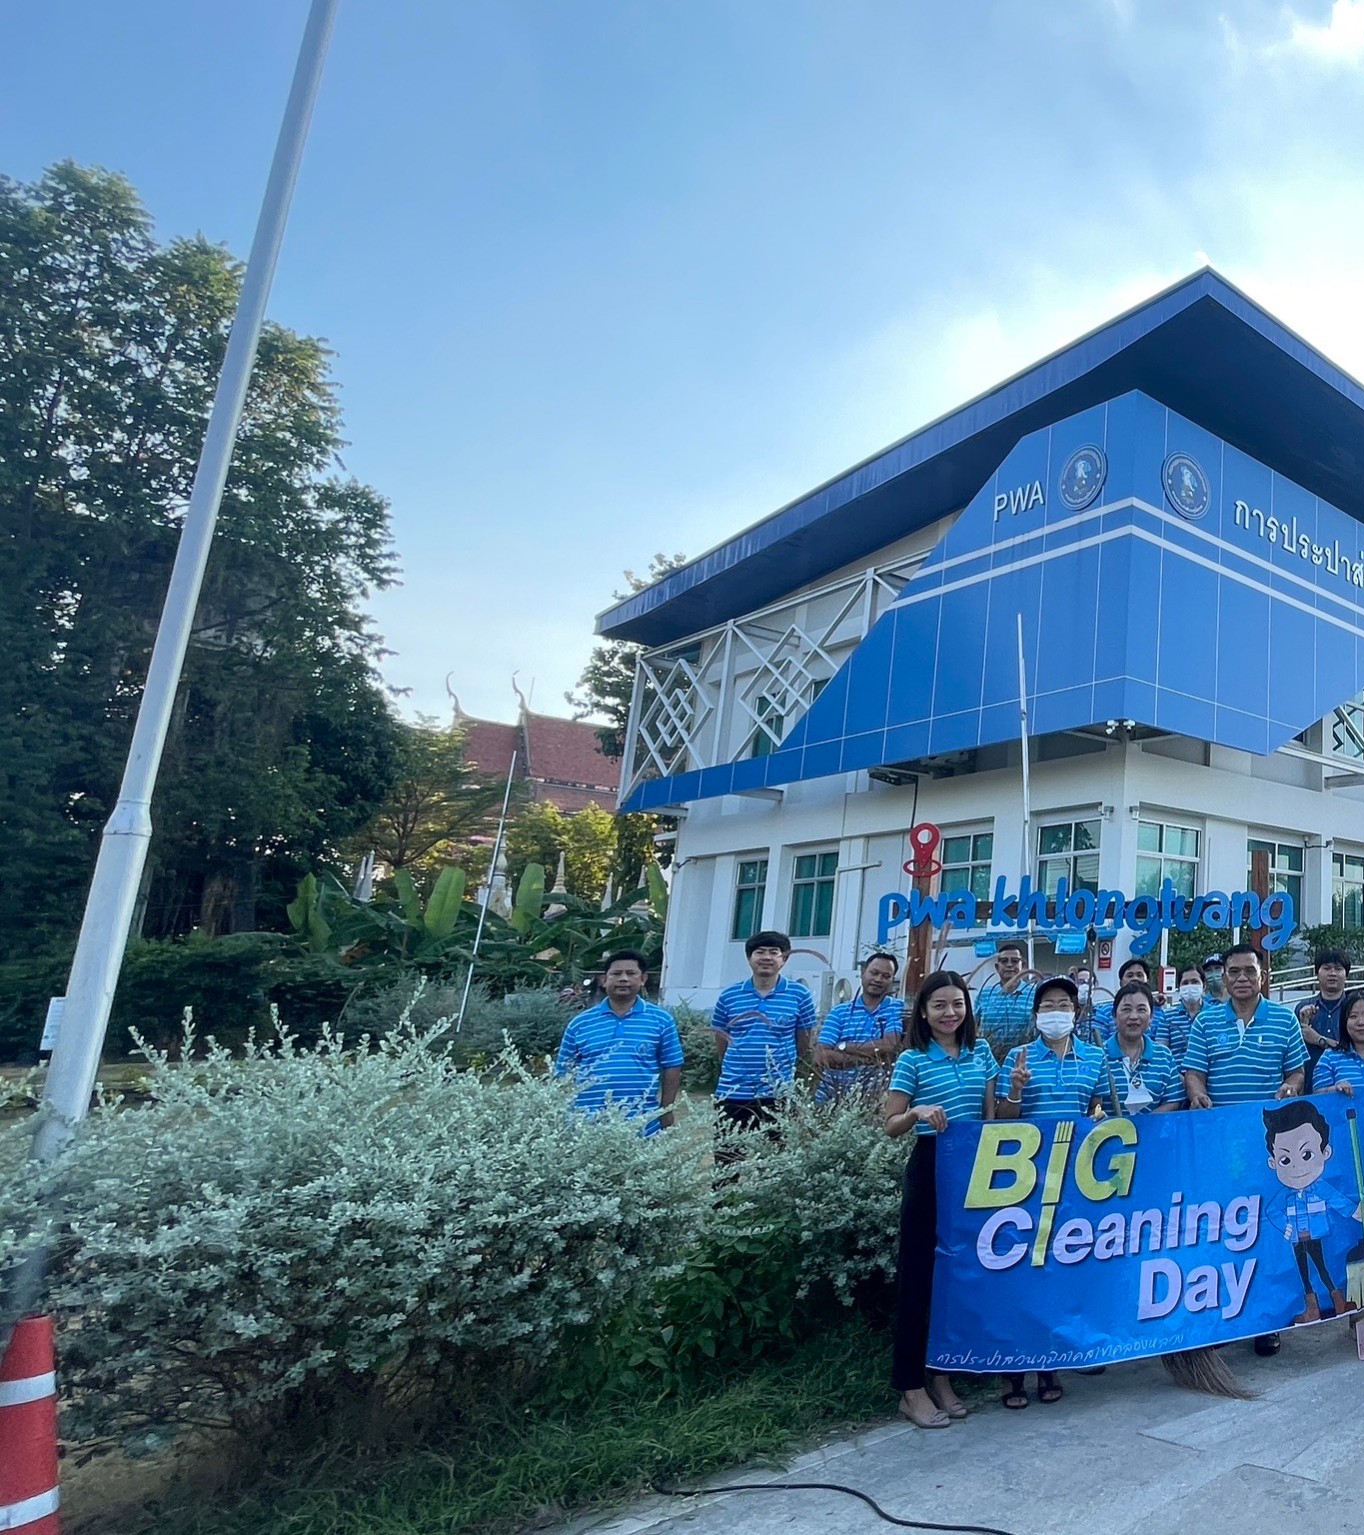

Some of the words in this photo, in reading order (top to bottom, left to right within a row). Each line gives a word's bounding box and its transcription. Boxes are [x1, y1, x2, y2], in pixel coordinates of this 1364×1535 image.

[993, 480, 1045, 522] PWA
[877, 888, 976, 945] pwa
[975, 1191, 1261, 1270] Cleaning
[1136, 1257, 1257, 1322] Day
